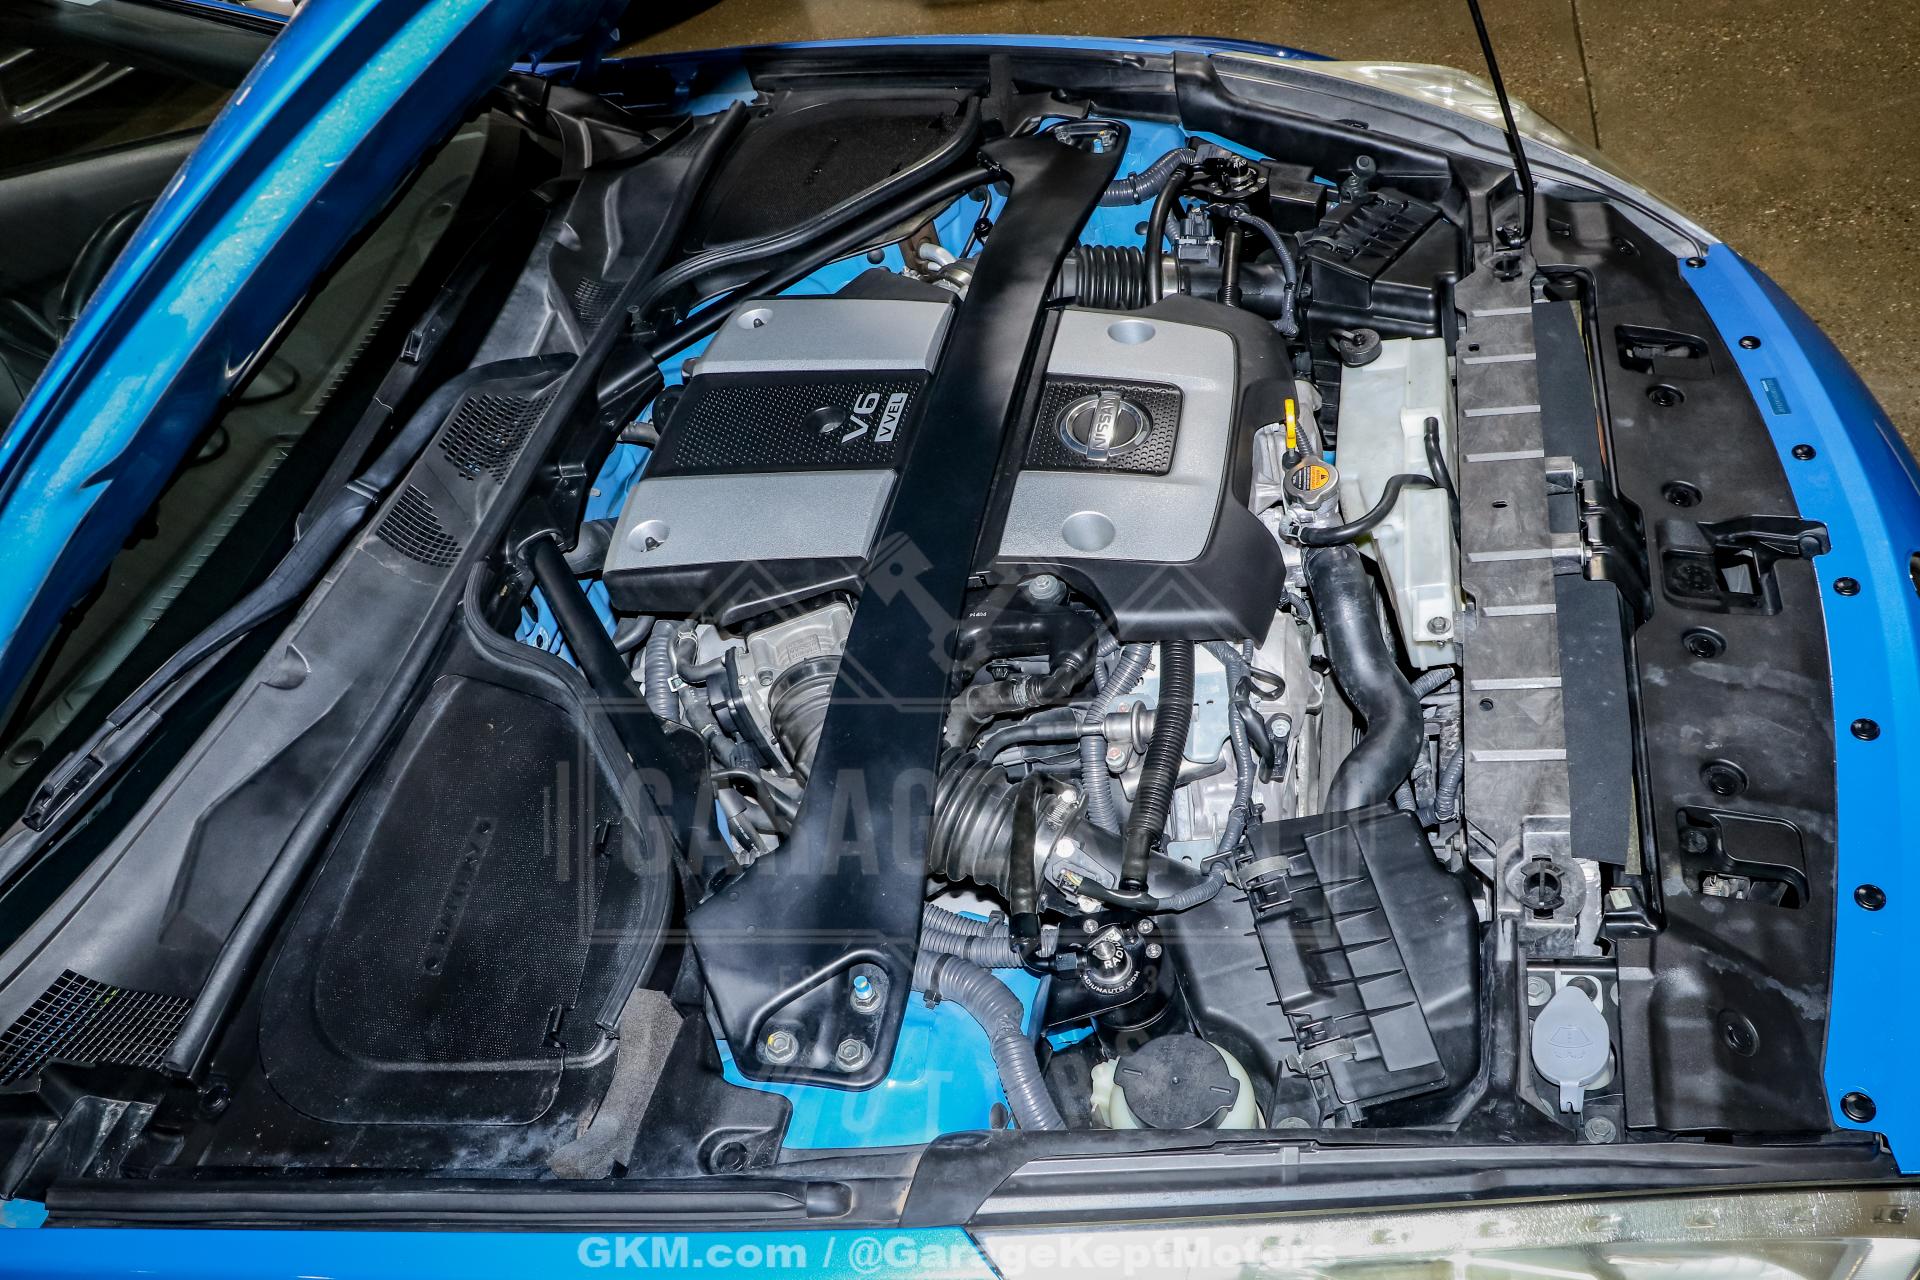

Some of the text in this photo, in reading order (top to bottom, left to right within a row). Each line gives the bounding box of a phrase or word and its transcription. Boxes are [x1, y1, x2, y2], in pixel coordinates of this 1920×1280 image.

[841, 392, 881, 444] V6
[1094, 399, 1117, 448] NISSAN
[1080, 970, 1141, 995] ADIUMAUTO.COM
